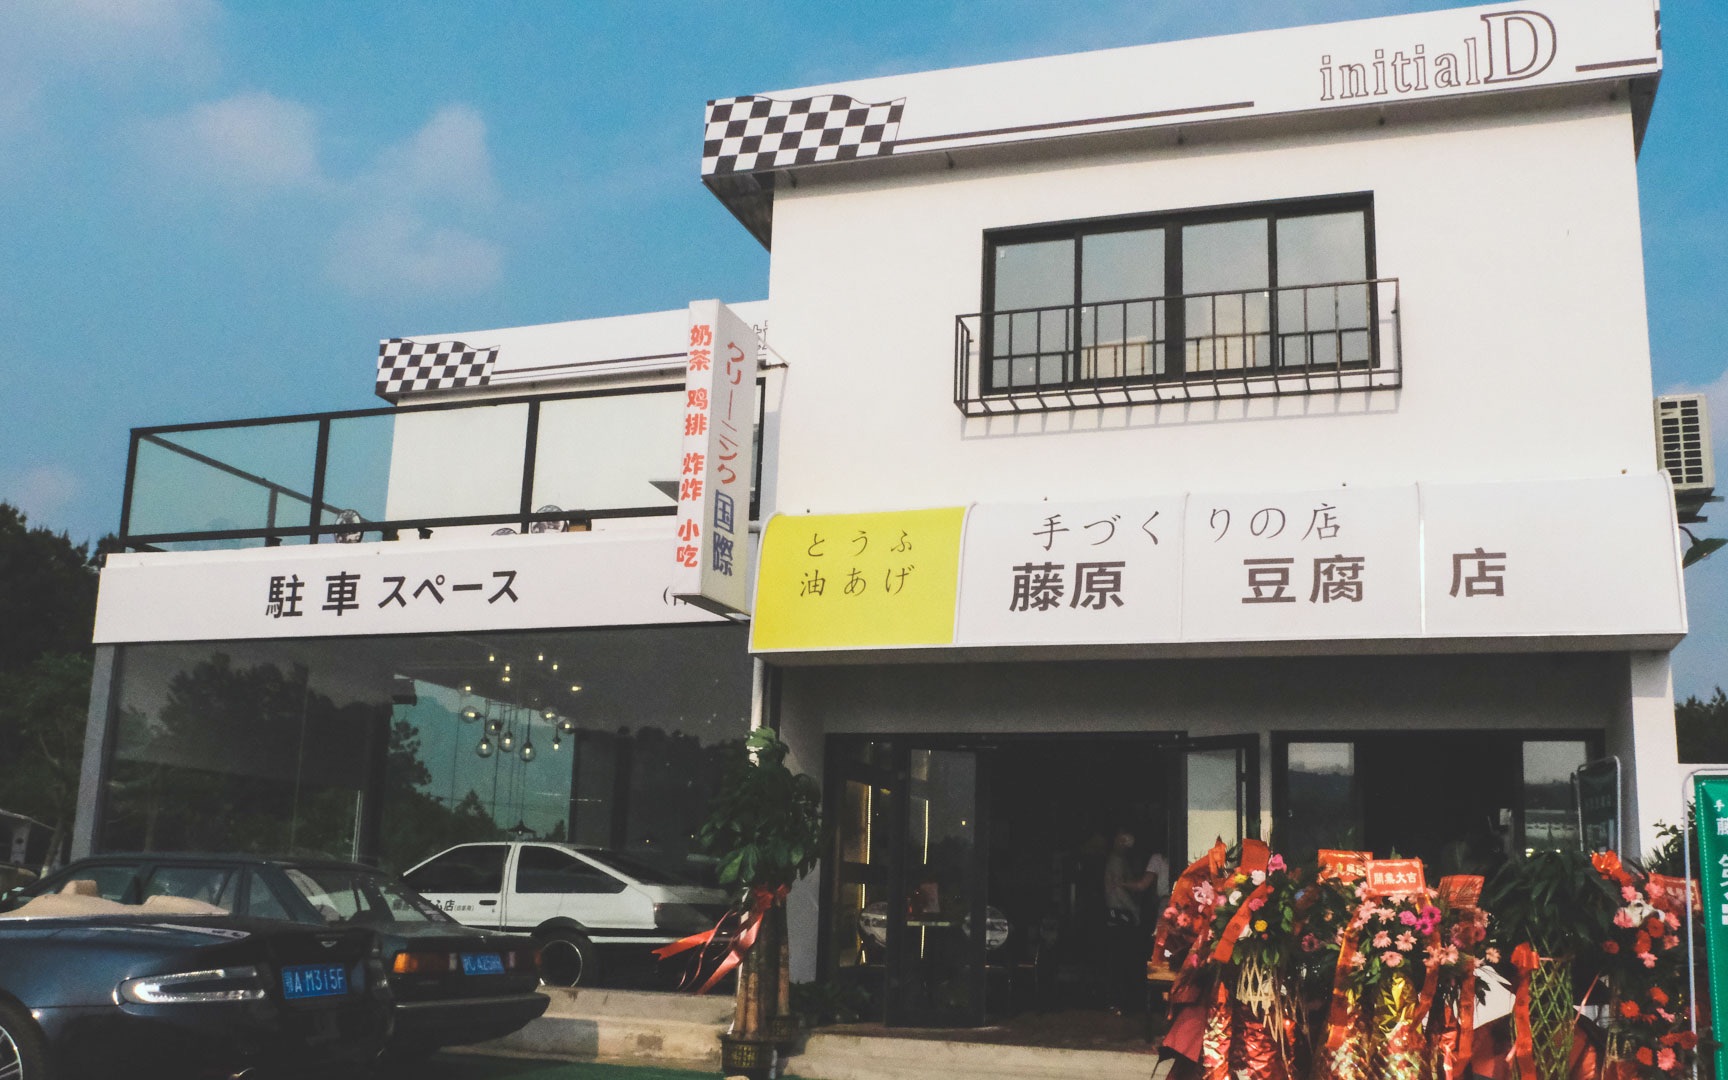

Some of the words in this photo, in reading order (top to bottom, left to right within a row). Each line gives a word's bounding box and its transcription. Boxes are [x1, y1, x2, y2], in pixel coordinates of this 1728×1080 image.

[689, 324, 712, 372] 奶茶
[685, 387, 708, 436] 鸡排
[681, 452, 704, 501] 炸炸
[676, 518, 699, 568] 小吃
[807, 530, 912, 557] とうふ
[800, 564, 914, 598] 油あげ
[1009, 560, 1126, 612] 藤原
[1242, 554, 1365, 604] 豆腐
[1449, 547, 1507, 598] 店
